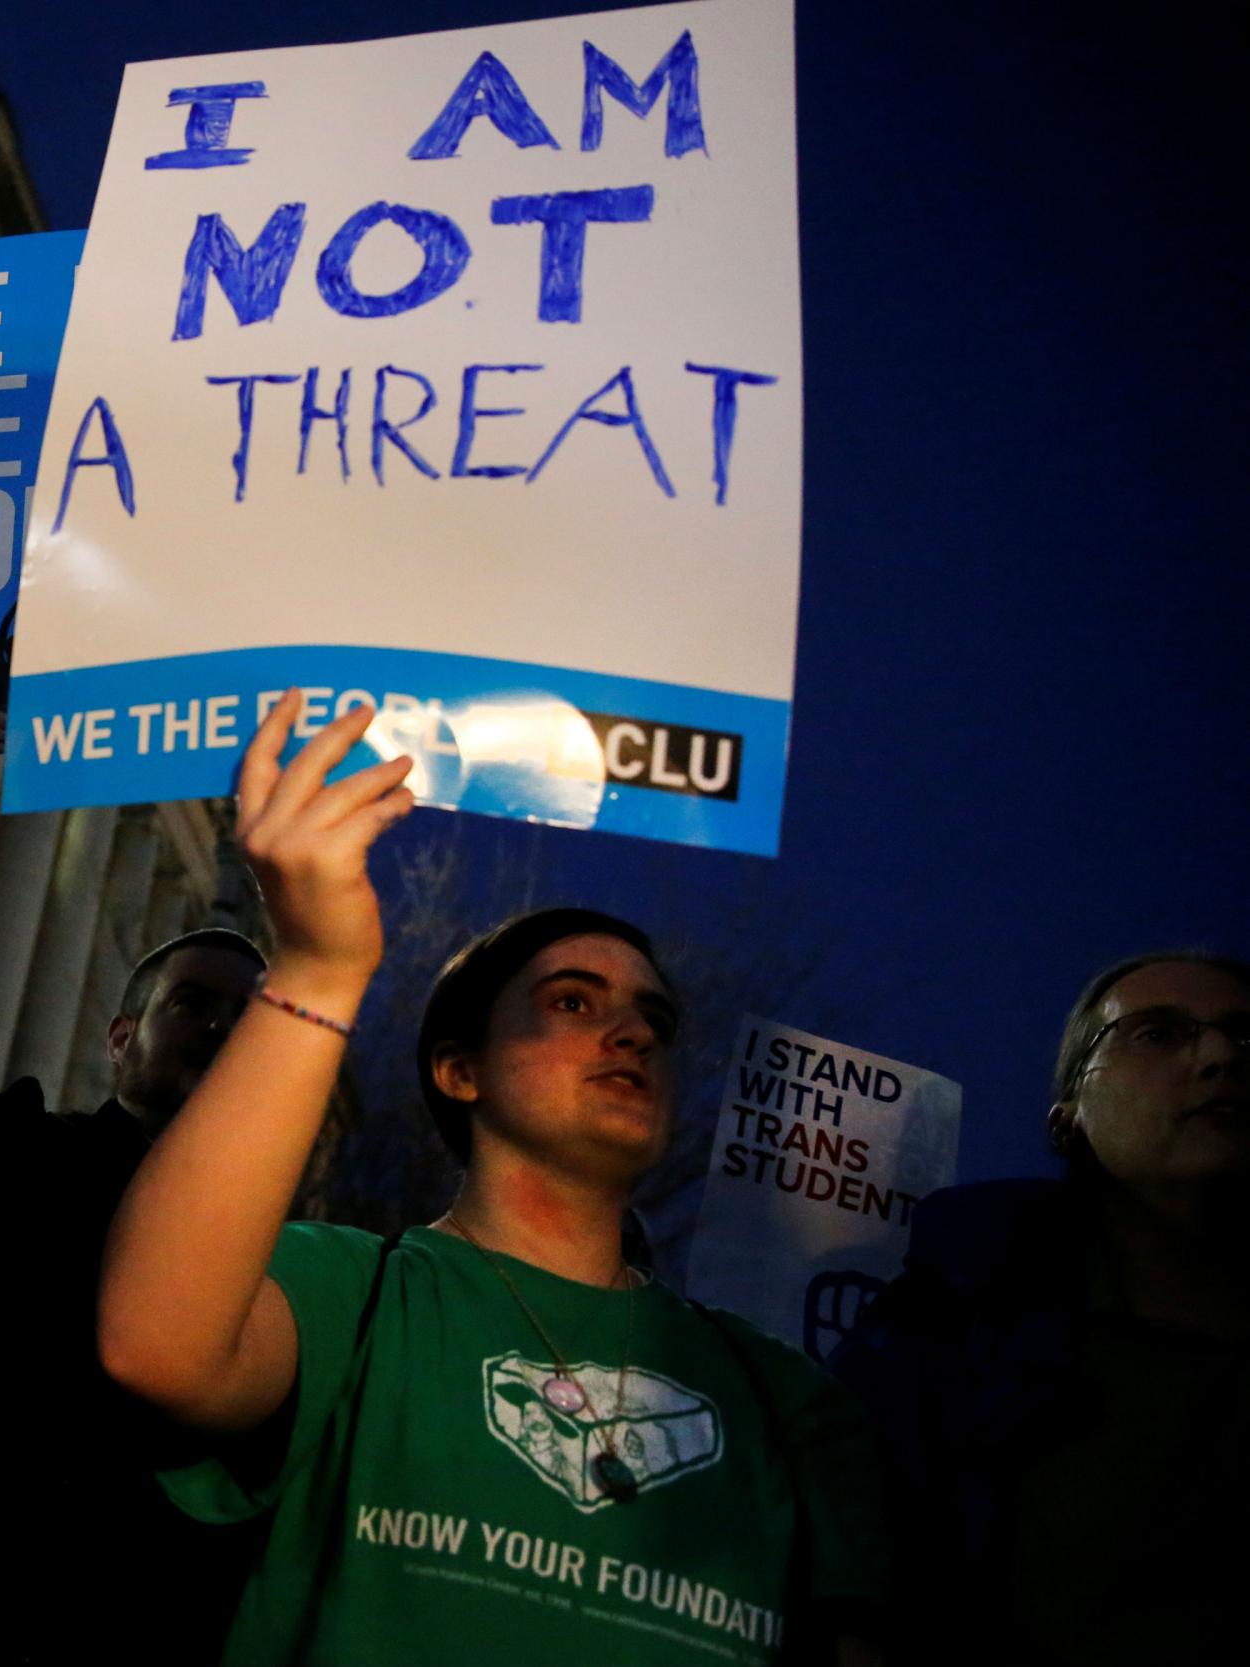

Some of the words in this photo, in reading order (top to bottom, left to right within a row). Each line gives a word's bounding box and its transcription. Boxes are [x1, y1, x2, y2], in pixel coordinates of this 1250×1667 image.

[144, 80, 270, 171] I
[407, 28, 711, 160] AM
[170, 183, 655, 342] NOT
[51, 395, 135, 535] A
[206, 361, 779, 506] THREAT
[31, 708, 115, 765] WE
[128, 694, 239, 755] THE
[605, 724, 734, 793] CLU
[739, 1066, 843, 1127] WITH
[744, 1029, 759, 1061] I
[765, 1037, 902, 1103] STAND
[732, 1104, 870, 1173] TRANS
[357, 1505, 468, 1556] KNOW
[481, 1522, 586, 1588] YOUR
